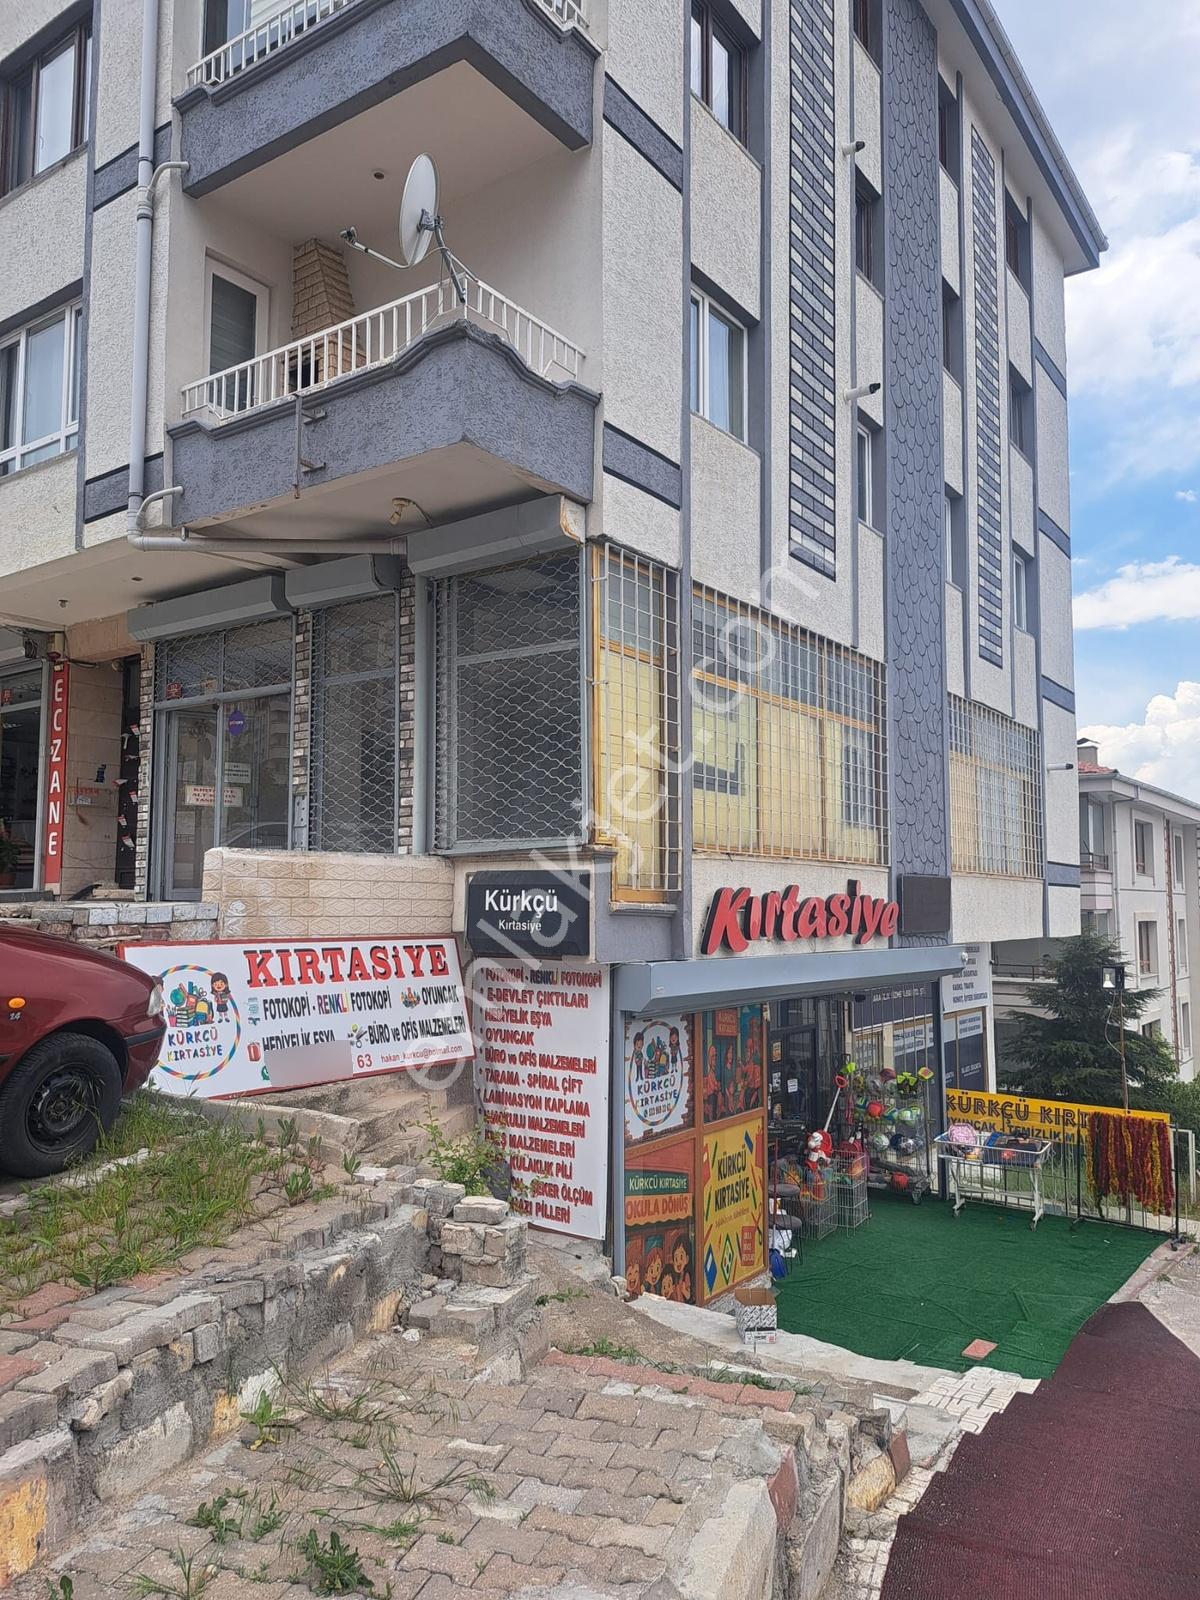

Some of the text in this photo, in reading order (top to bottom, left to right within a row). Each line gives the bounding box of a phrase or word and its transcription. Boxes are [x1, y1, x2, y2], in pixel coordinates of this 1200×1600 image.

[48, 678, 64, 856] ECZANE
[485, 889, 558, 923] Kürkçü
[701, 879, 899, 955] Kırtasiye
[498, 919, 542, 933] Kırtasiye
[561, 970, 602, 988] FOTOKOPİ
[263, 992, 311, 1021] FOTOKOPİ
[317, 988, 349, 1016] RENKLİ
[350, 986, 393, 1012] FOTOKOPİ
[421, 984, 460, 1006] OYUNCAK
[487, 987, 589, 1009] E-DEVLET ÇIKTILARI
[368, 1010, 467, 1045] BÜRO ve OFİS MALZEMELERİ
[530, 1011, 552, 1029] EŞYA
[486, 1028, 535, 1046] OYUNCAK
[357, 1053, 373, 1069] 63
[485, 1047, 597, 1074] BÜRO ve OFİS MALZEMELERİ
[485, 1068, 520, 1087] TARAMA
[527, 1071, 559, 1092] SPİRAL
[562, 1075, 583, 1095] ÇİFT
[483, 1089, 591, 1118] LAMİNASYON KAPLAMA
[946, 1091, 1089, 1129] KÜRKÇÜ KIRT
[528, 1115, 585, 1138] MALZEMELERİ
[949, 1116, 997, 1132] YUNCAK
[509, 1133, 576, 1158] MALZEMELERİ
[510, 1155, 554, 1177] KULAKLIK
[555, 1160, 573, 1180] PİLİ
[561, 1183, 593, 1207] ÖLÇÜM
[714, 1175, 750, 1212] KIRTASİYE
[535, 1200, 571, 1224] PİLLERİ
[626, 1194, 689, 1220] OKULA DÖNÜŞ
